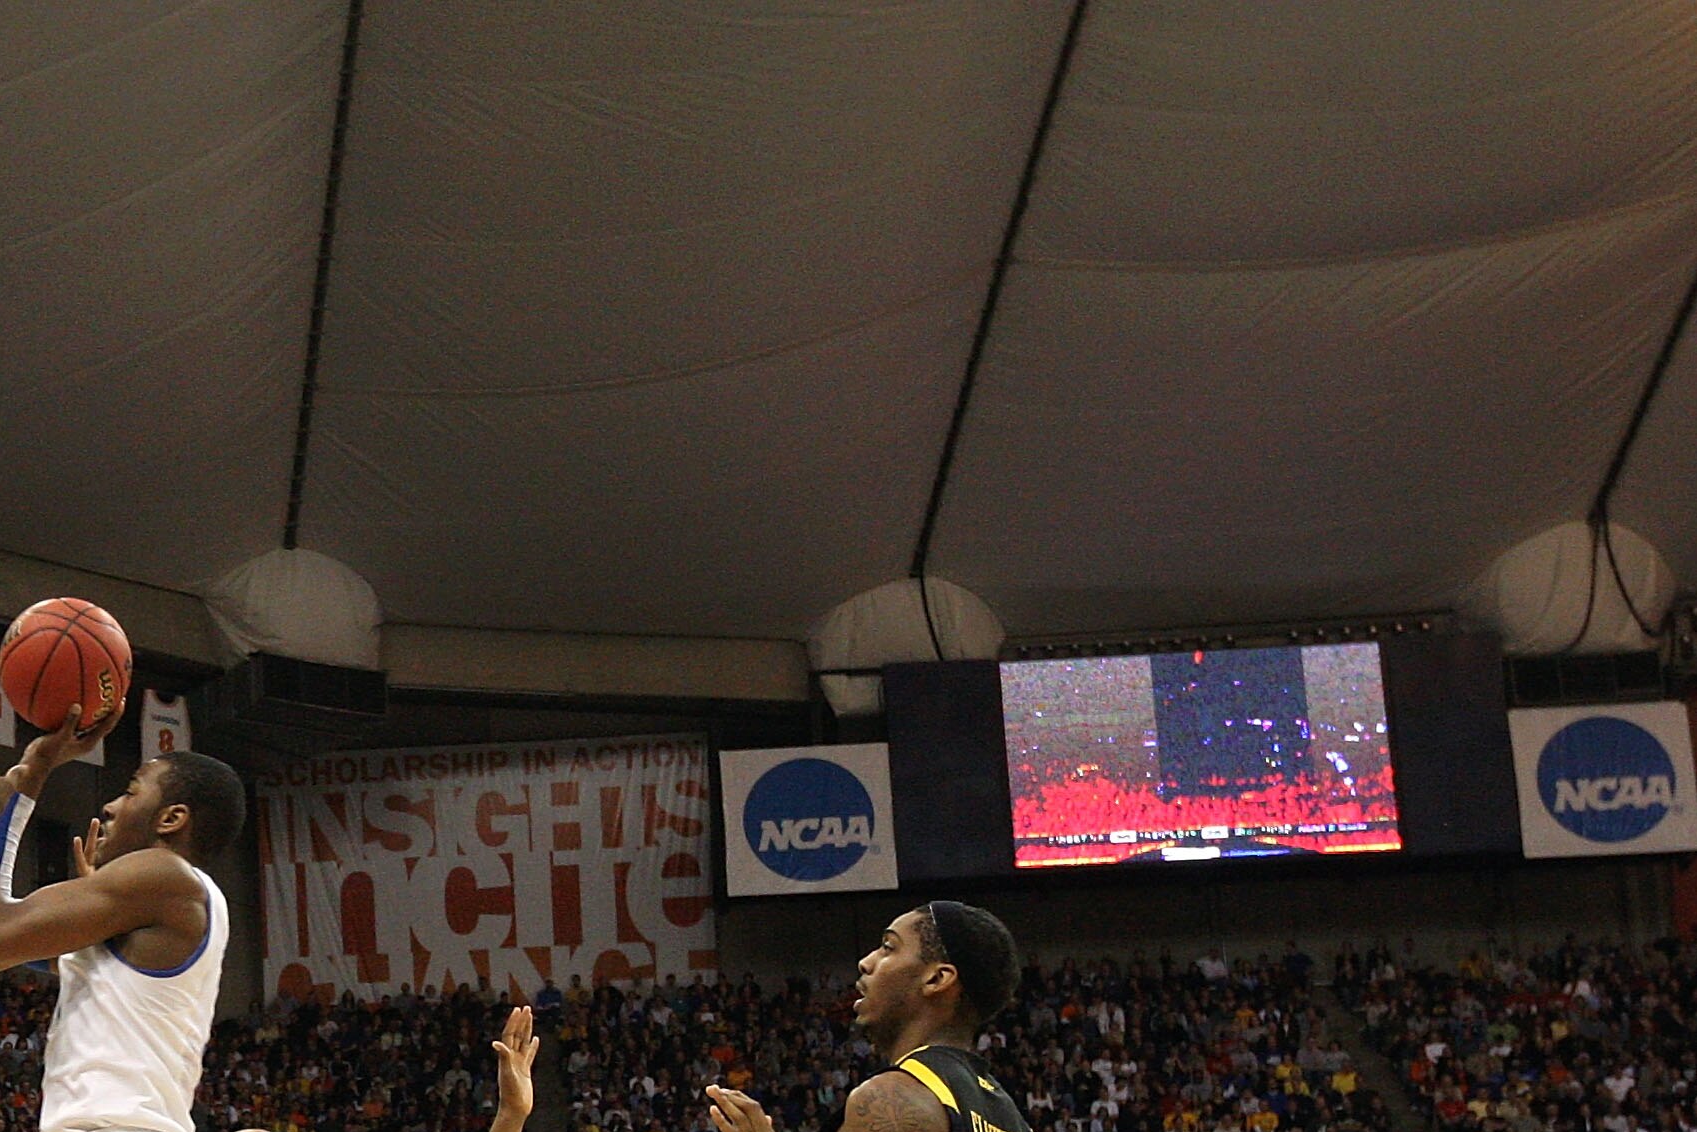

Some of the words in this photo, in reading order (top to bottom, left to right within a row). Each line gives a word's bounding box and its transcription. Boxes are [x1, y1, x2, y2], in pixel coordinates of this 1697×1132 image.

[158, 727, 174, 753] 8
[264, 750, 509, 788] SCHOLARSHIP
[523, 747, 556, 774] IN
[573, 740, 700, 773] ACTION
[1554, 775, 1674, 814] NCAA
[267, 780, 709, 864] INSIGHTS
[759, 815, 870, 852] NCAA
